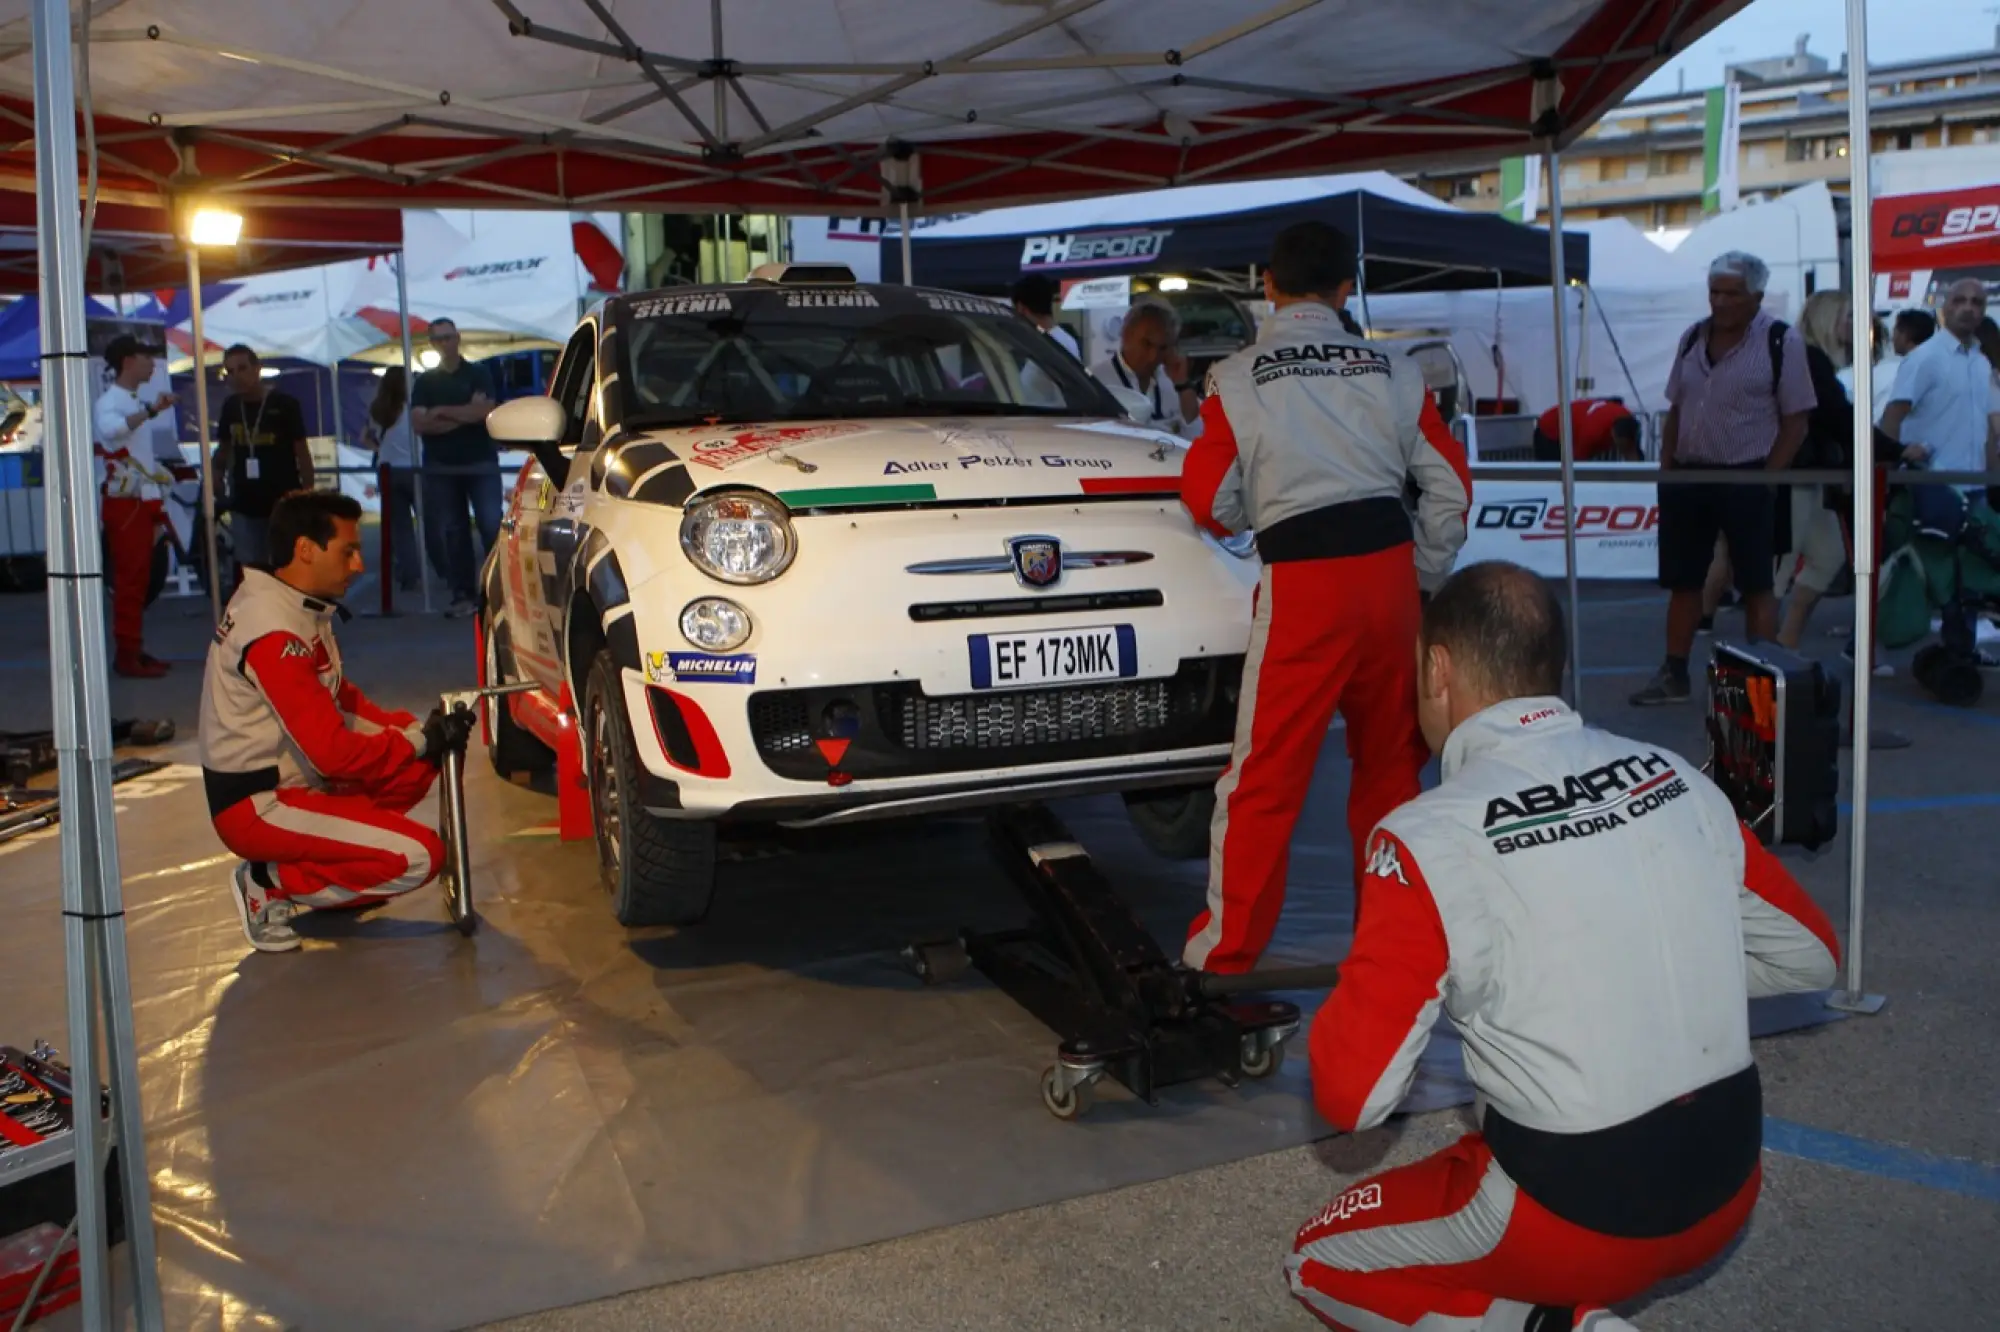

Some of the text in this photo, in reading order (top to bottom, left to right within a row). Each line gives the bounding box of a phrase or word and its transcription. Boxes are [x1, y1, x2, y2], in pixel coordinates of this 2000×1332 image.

[634, 297, 732, 319] SELENIA
[786, 294, 880, 307] SELENIA
[1252, 344, 1391, 373] ABARTH
[1255, 366, 1337, 386] SQUADRA
[883, 455, 1112, 475] Adler Pelzer Group
[677, 659, 755, 673] MICHELIN
[996, 633, 1114, 680] EF 173MK
[1483, 752, 1671, 829] ABARTH
[1493, 778, 1690, 855] SQUADRA CORSE
